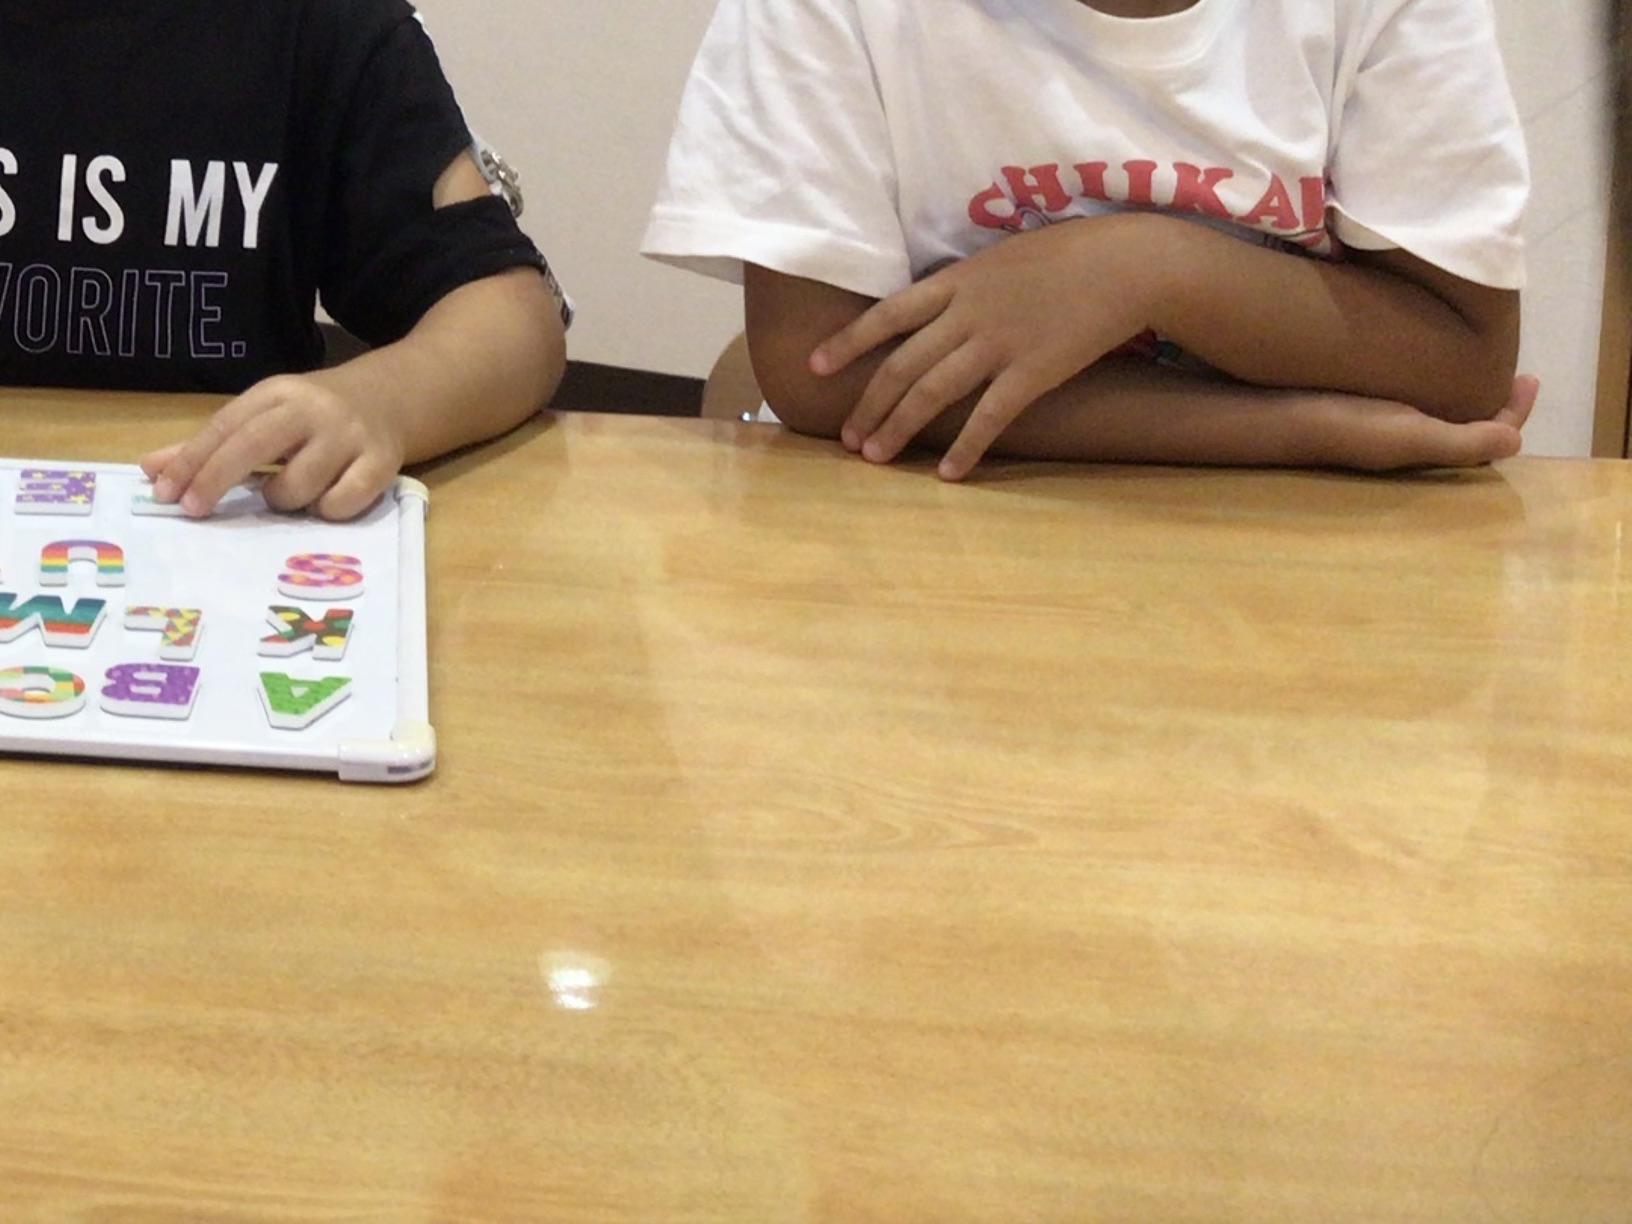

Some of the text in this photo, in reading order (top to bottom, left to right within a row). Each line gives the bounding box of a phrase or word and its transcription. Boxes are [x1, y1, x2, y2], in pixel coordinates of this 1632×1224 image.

[57, 154, 126, 244] IS
[164, 159, 279, 249] MY
[257, 672, 352, 731] A
